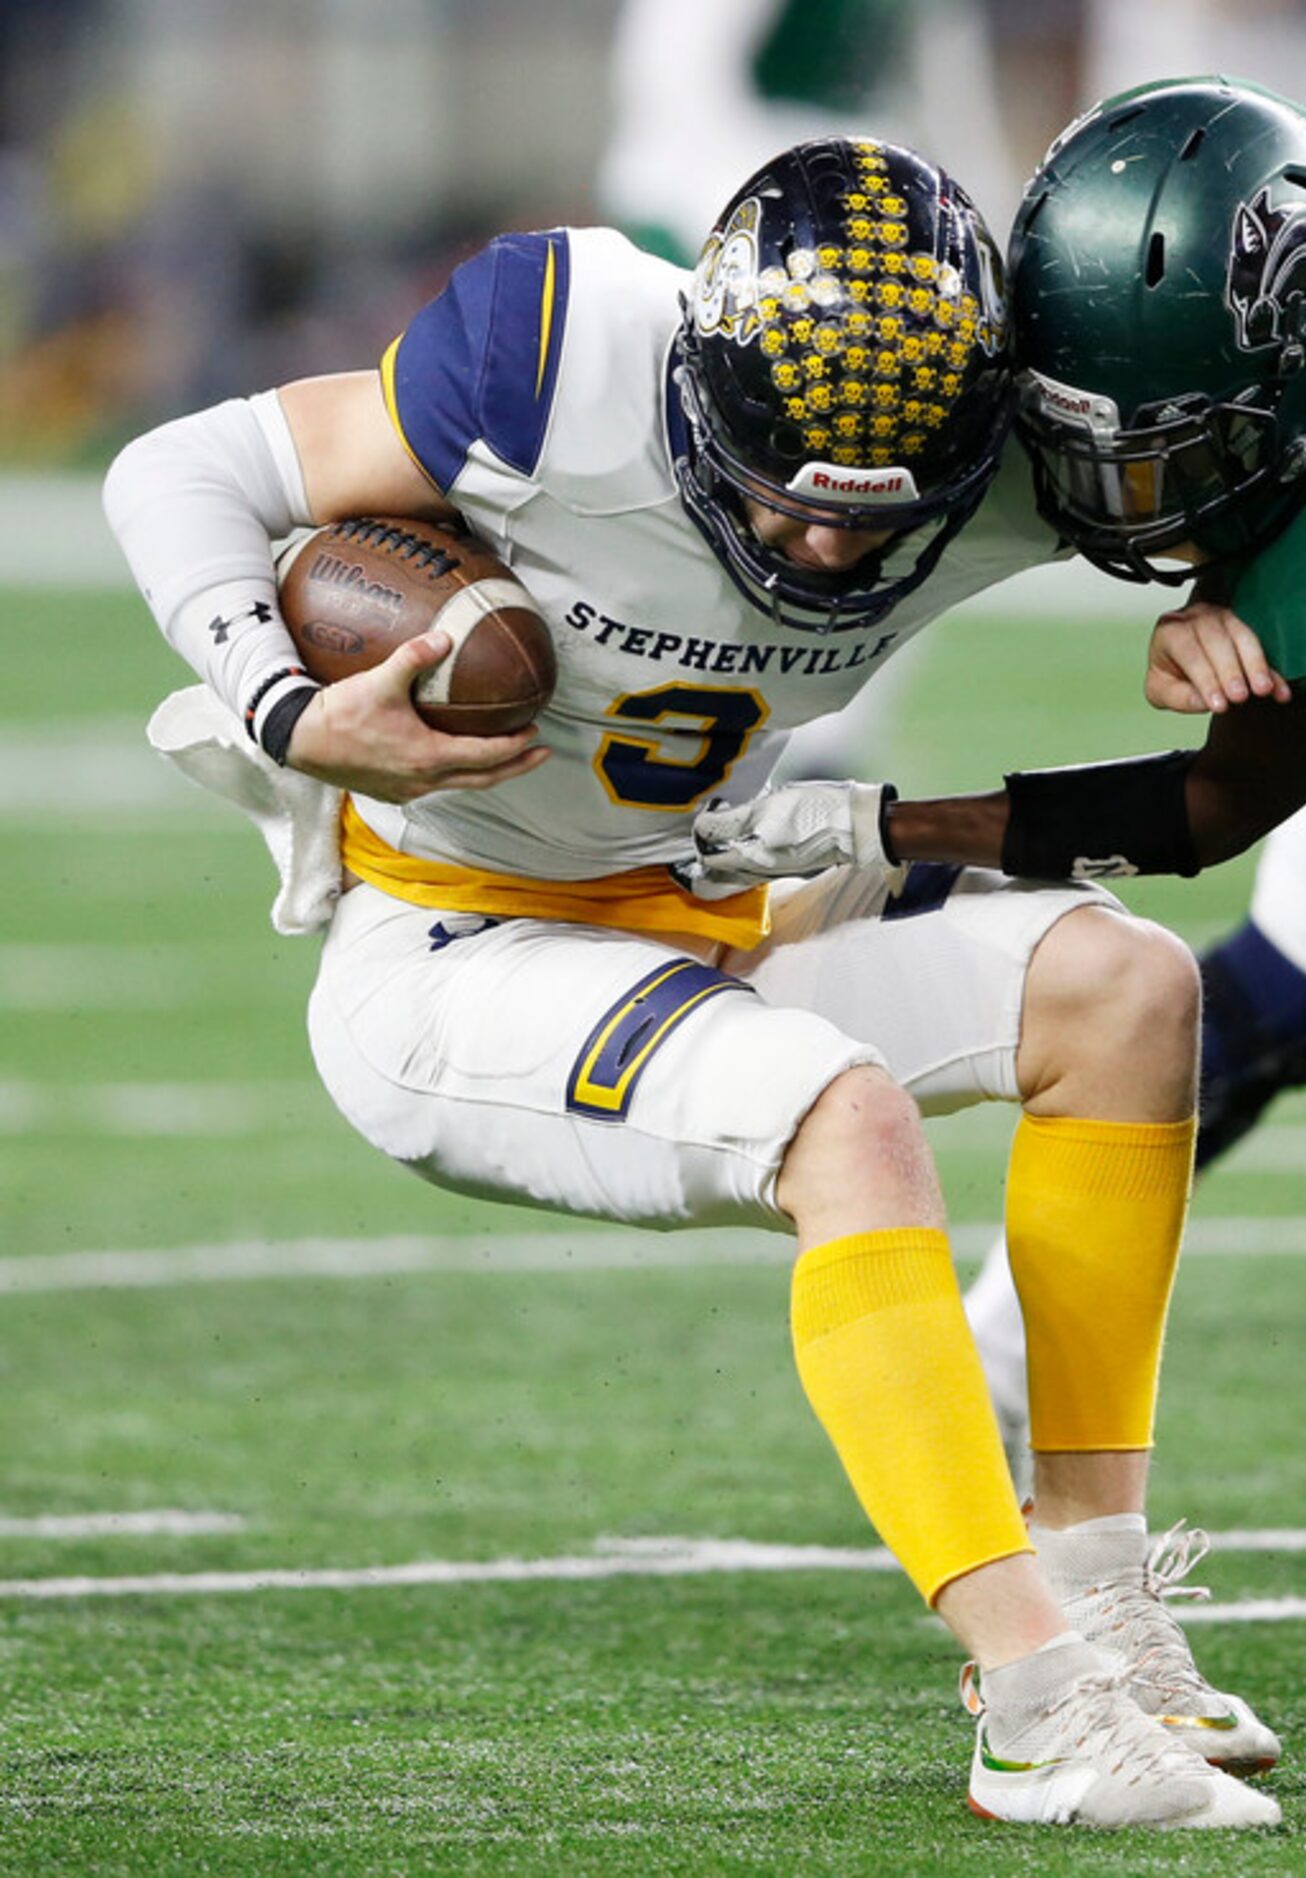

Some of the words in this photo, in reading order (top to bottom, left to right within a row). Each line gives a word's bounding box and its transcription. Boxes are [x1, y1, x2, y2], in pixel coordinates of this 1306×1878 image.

[812, 472, 903, 493] Riddell
[308, 551, 406, 614] Wilson
[565, 601, 898, 675] STEPHENVILLE
[592, 680, 771, 812] 3
